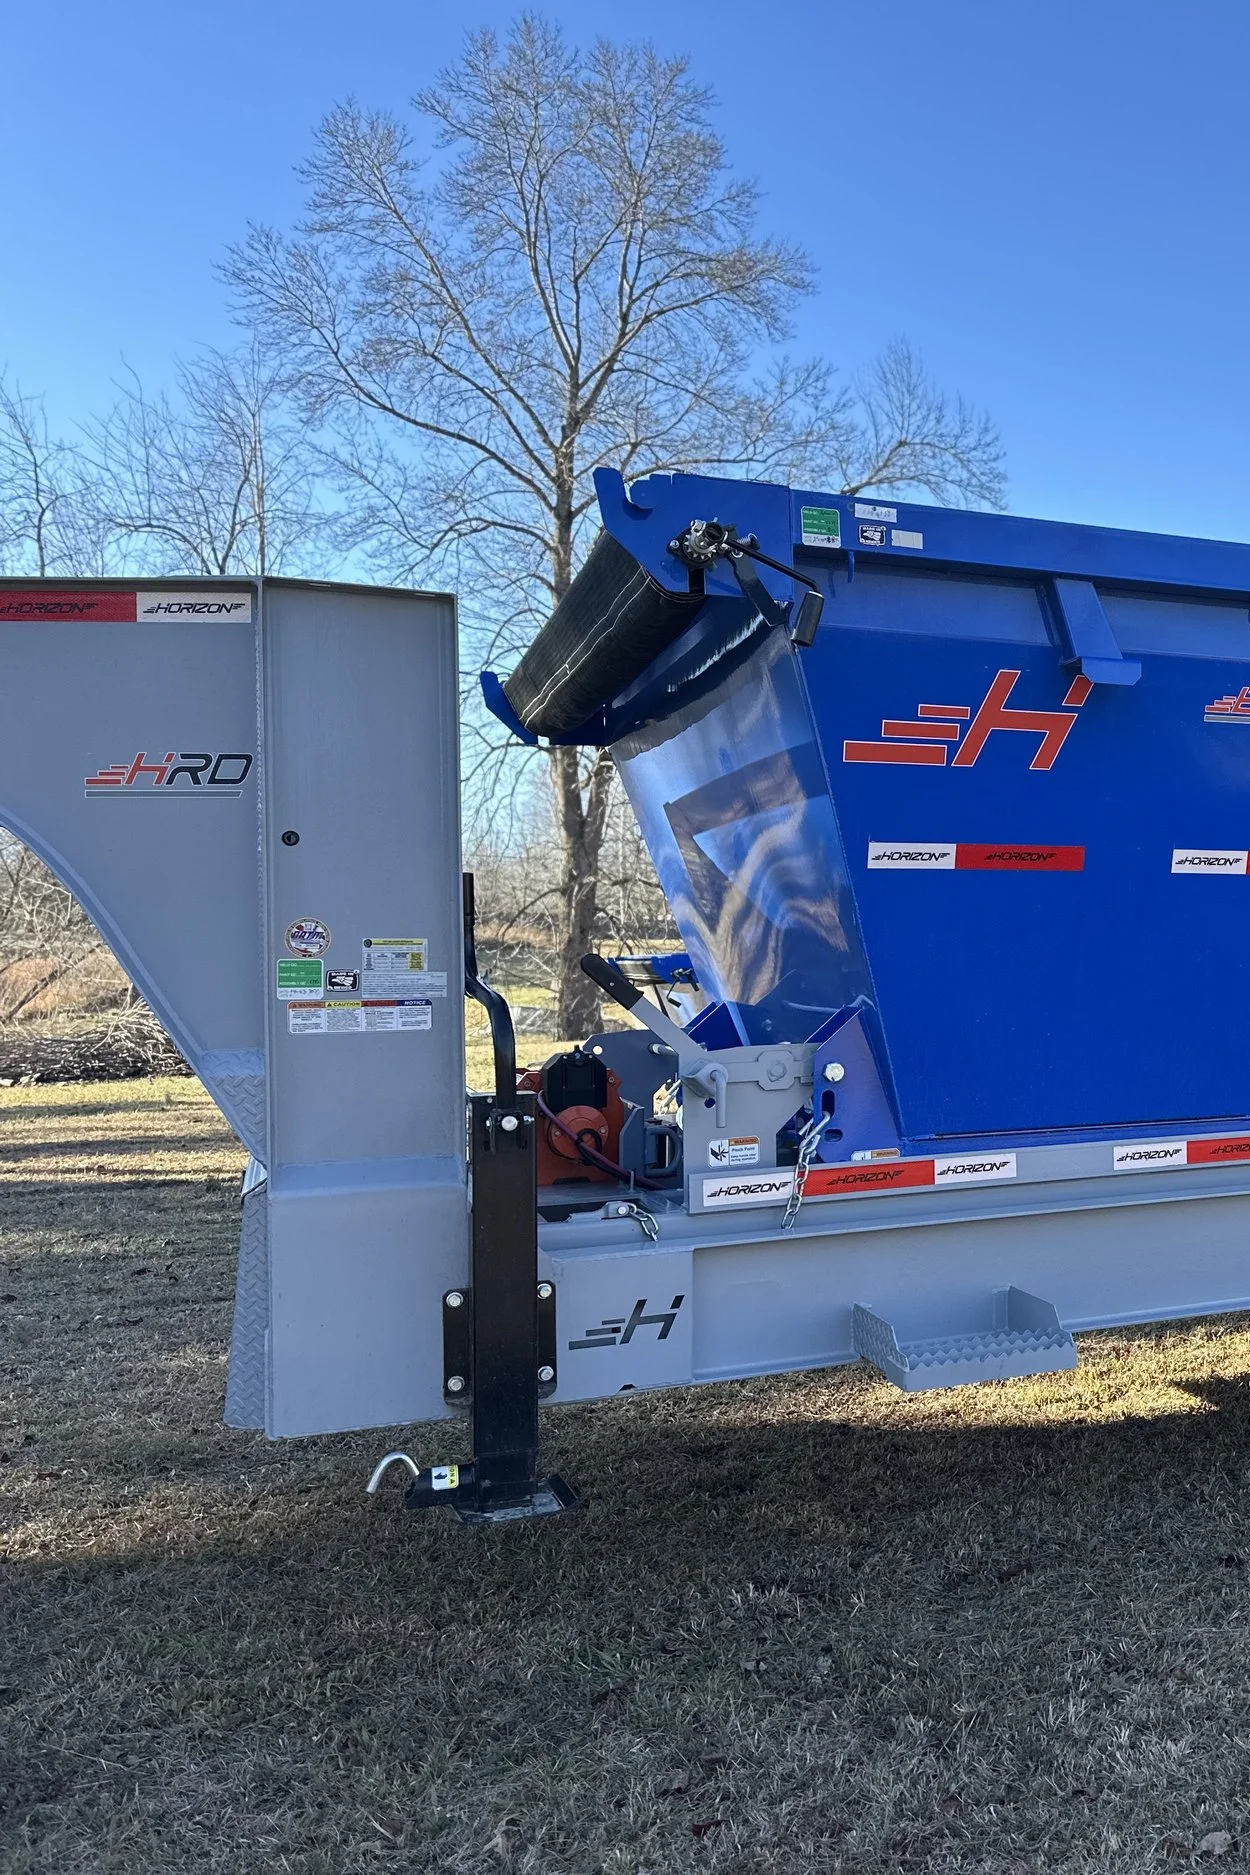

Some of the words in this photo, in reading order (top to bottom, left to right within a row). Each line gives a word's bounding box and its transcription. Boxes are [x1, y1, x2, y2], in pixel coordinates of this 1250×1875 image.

[6, 602, 85, 614] HORIZON
[155, 602, 234, 614] HORIZON
[123, 751, 254, 786] HRD
[881, 851, 940, 862] HORIZON
[991, 852, 1049, 862] HORIZON
[1183, 856, 1235, 867] HORIZON
[1124, 1149, 1176, 1162] HORIZON
[944, 1161, 1003, 1176] HORIZON
[833, 1169, 896, 1185] HORIZON
[717, 1181, 782, 1197] HORIZON
